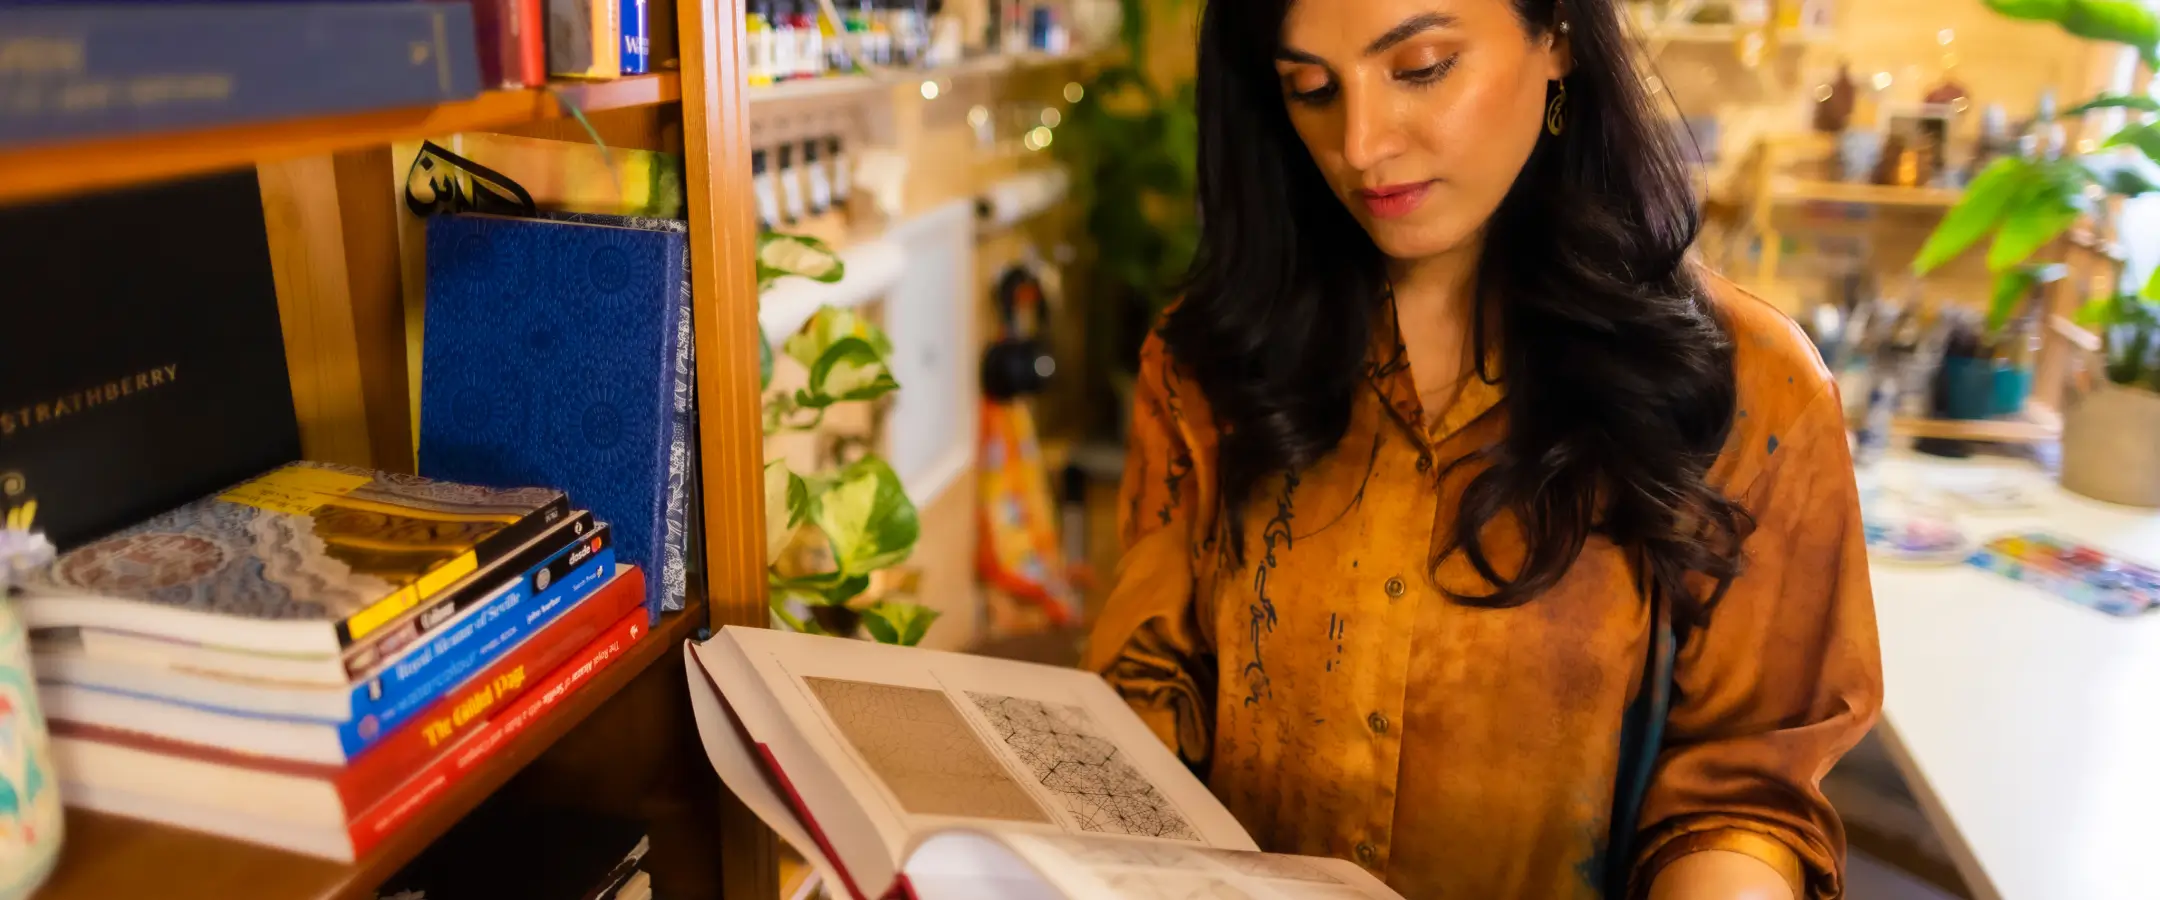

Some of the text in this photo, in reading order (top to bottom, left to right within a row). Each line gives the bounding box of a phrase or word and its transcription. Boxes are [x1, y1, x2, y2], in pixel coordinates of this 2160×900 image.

[0, 363, 177, 434] STRATHBERRY
[593, 648, 609, 667] Royal
[609, 641, 619, 653] The
[421, 716, 453, 747] The
